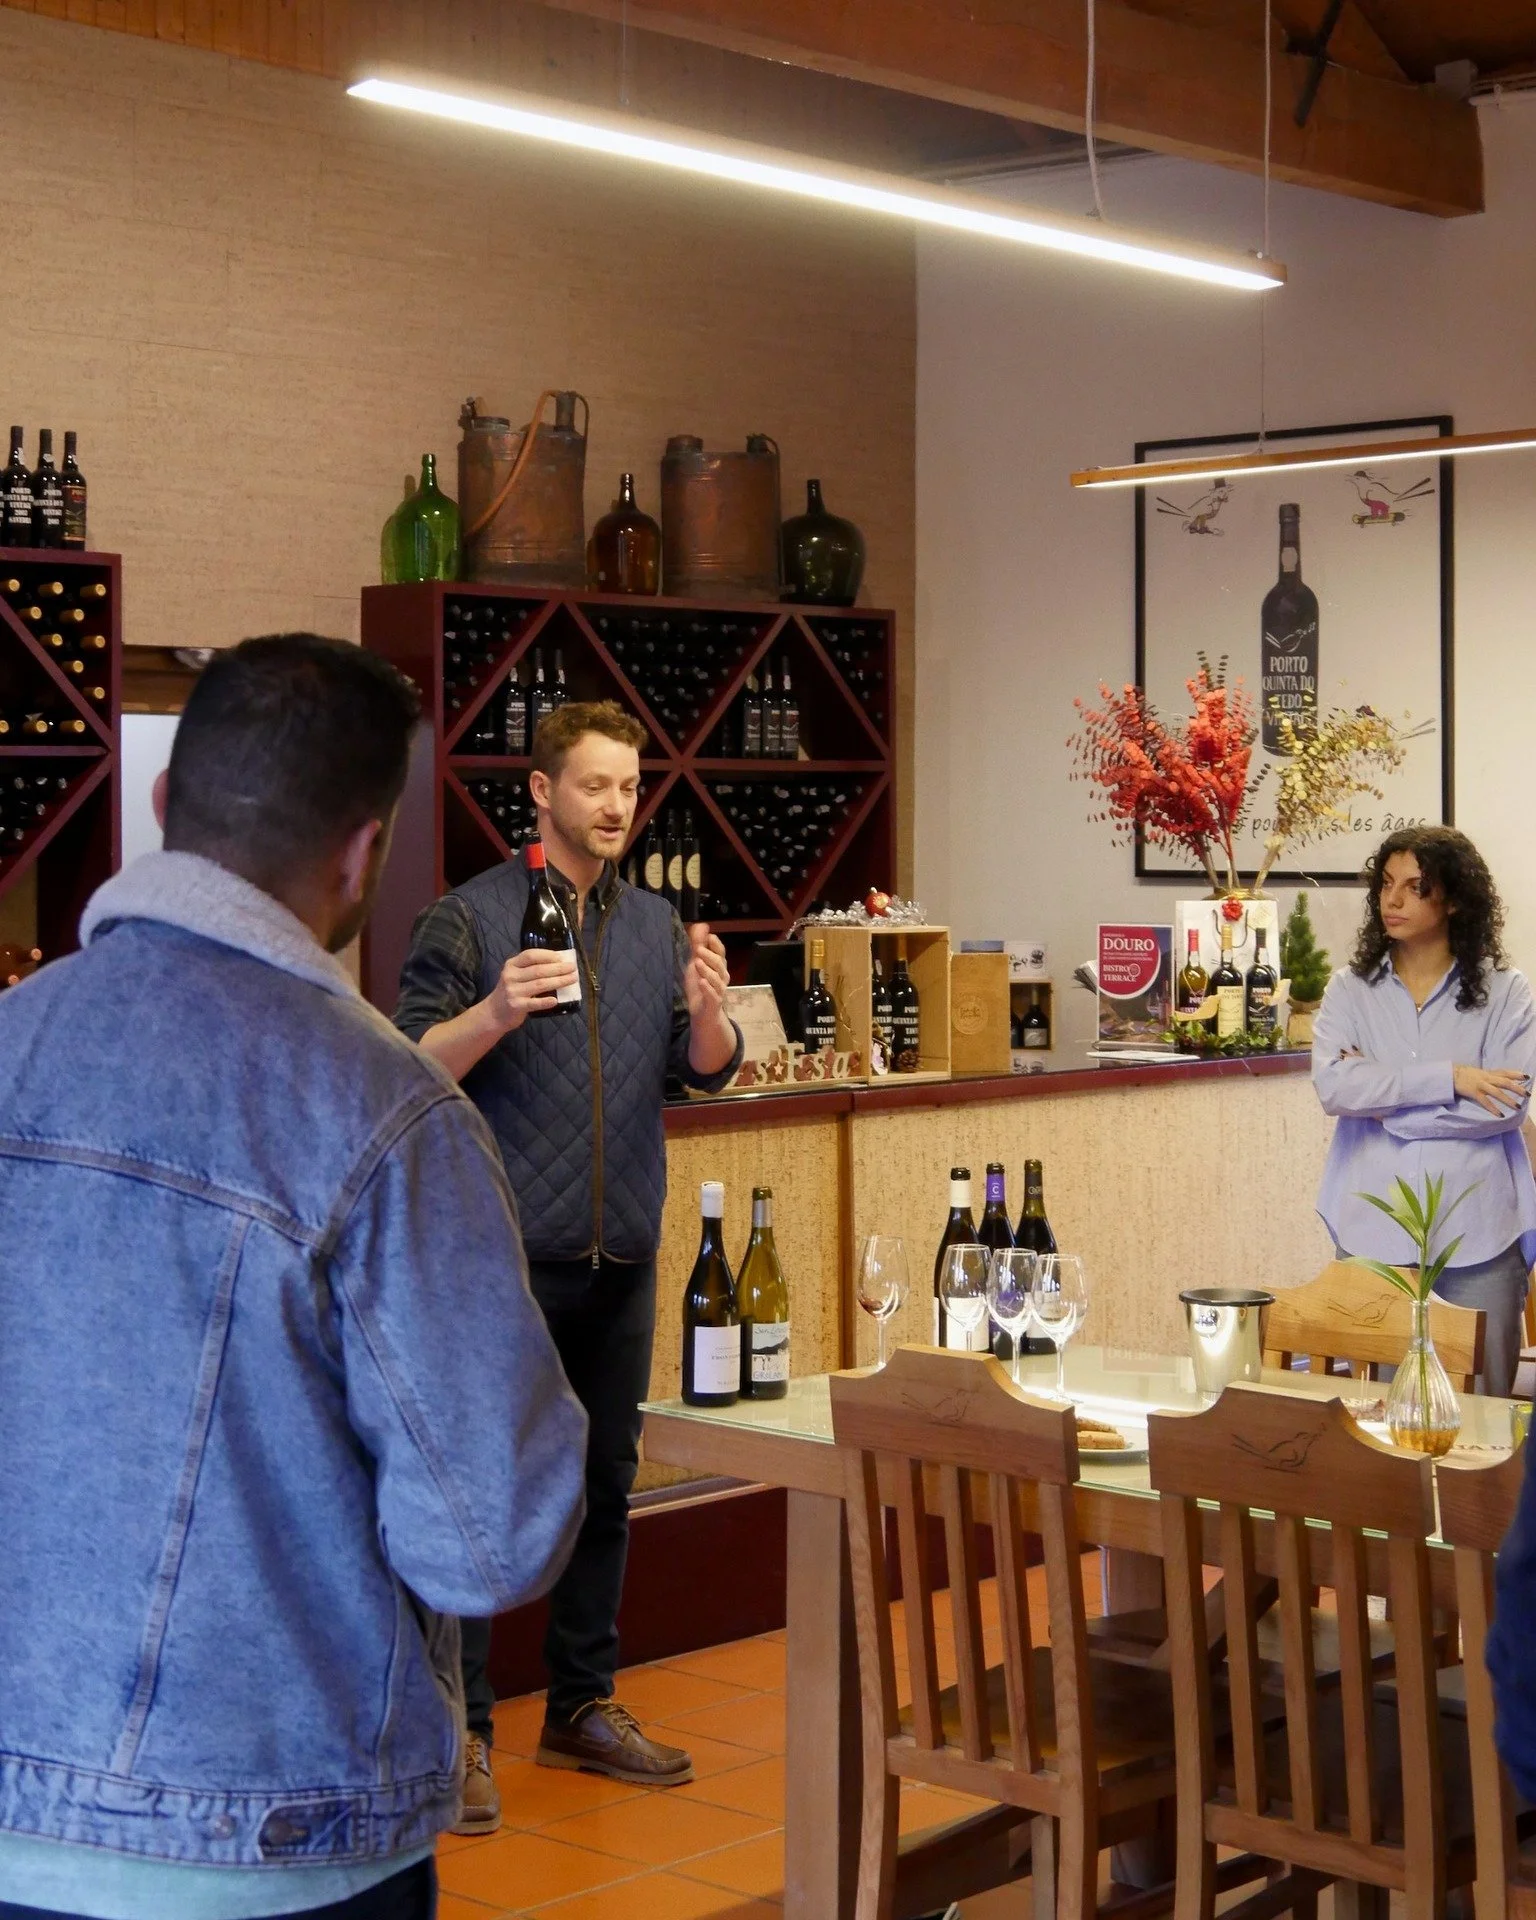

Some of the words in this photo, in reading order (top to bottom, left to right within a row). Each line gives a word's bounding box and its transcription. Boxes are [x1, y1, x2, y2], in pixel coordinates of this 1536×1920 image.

[1269, 656, 1309, 673] PORTO
[1262, 675, 1299, 691] QUINTA
[1300, 675, 1315, 692] DO
[1103, 937, 1155, 951] DOURO
[1103, 964, 1130, 973] BISTRO
[1103, 974, 1137, 983] TERRACE
